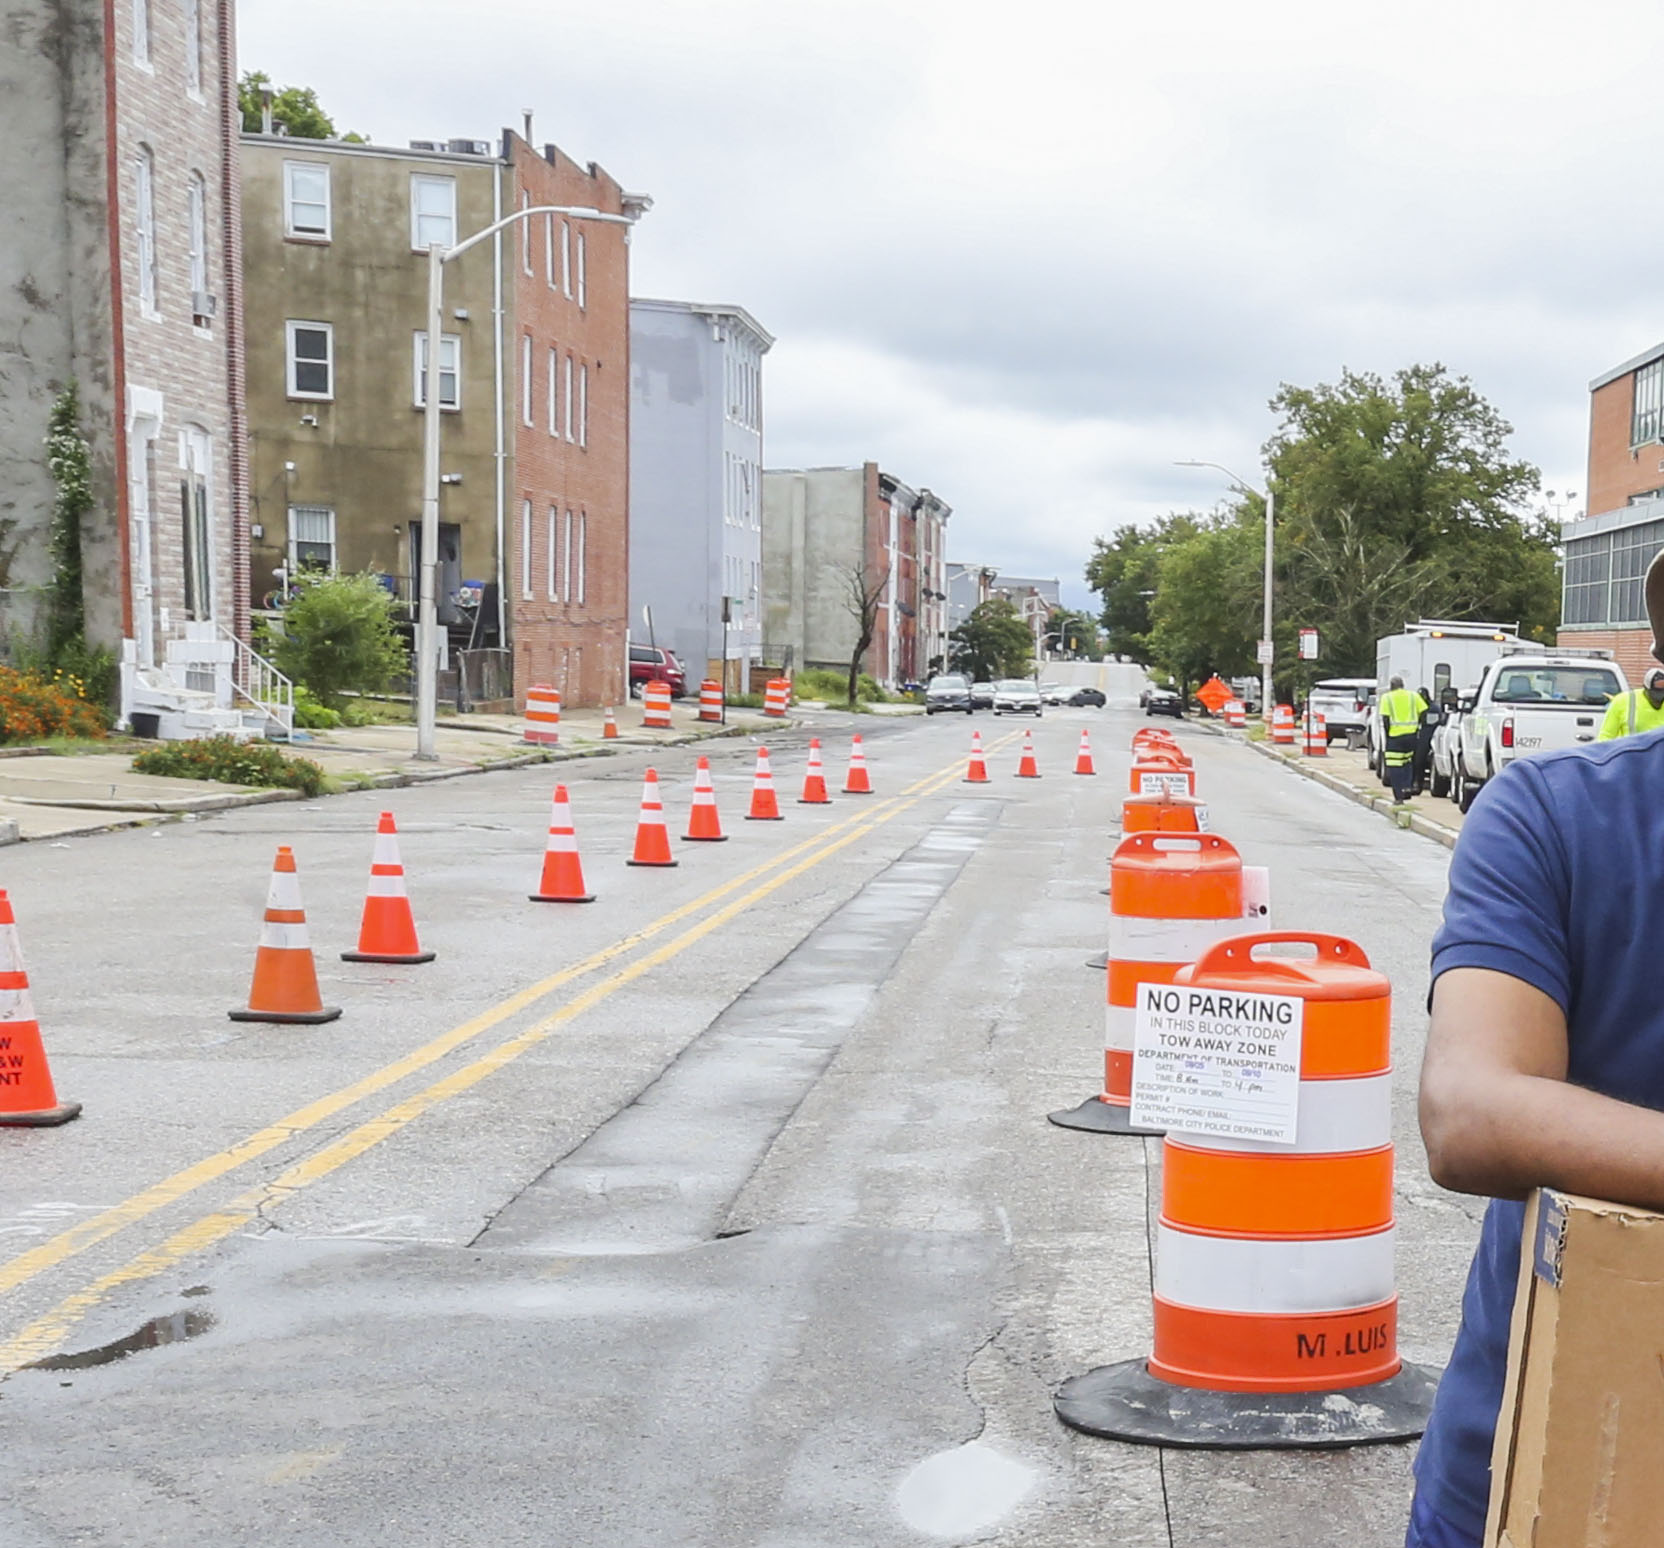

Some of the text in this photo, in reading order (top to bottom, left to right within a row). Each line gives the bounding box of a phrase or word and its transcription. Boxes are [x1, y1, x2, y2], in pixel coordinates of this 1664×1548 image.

[1147, 989, 1293, 1025] NO PARKING
[1150, 1017, 1288, 1041] IN THIS BLOCK TODAY
[1159, 1033, 1277, 1057] TOW AWAY ZONE
[1215, 1057, 1297, 1073] TRANSPORTATION
[1222, 1070, 1233, 1078] TO
[1136, 1082, 1187, 1095] DESCRIPTION
[1188, 1087, 1199, 1096] OF
[1221, 1080, 1232, 1089] TO
[1234, 1081, 1242, 1092] 4
[1136, 1092, 1164, 1102] PERMIT
[1135, 1102, 1176, 1115] CONTRACT
[1141, 1115, 1285, 1138] BALTIMORE CITY POLICE DEPARTMENT
[1297, 1332, 1325, 1358] M
